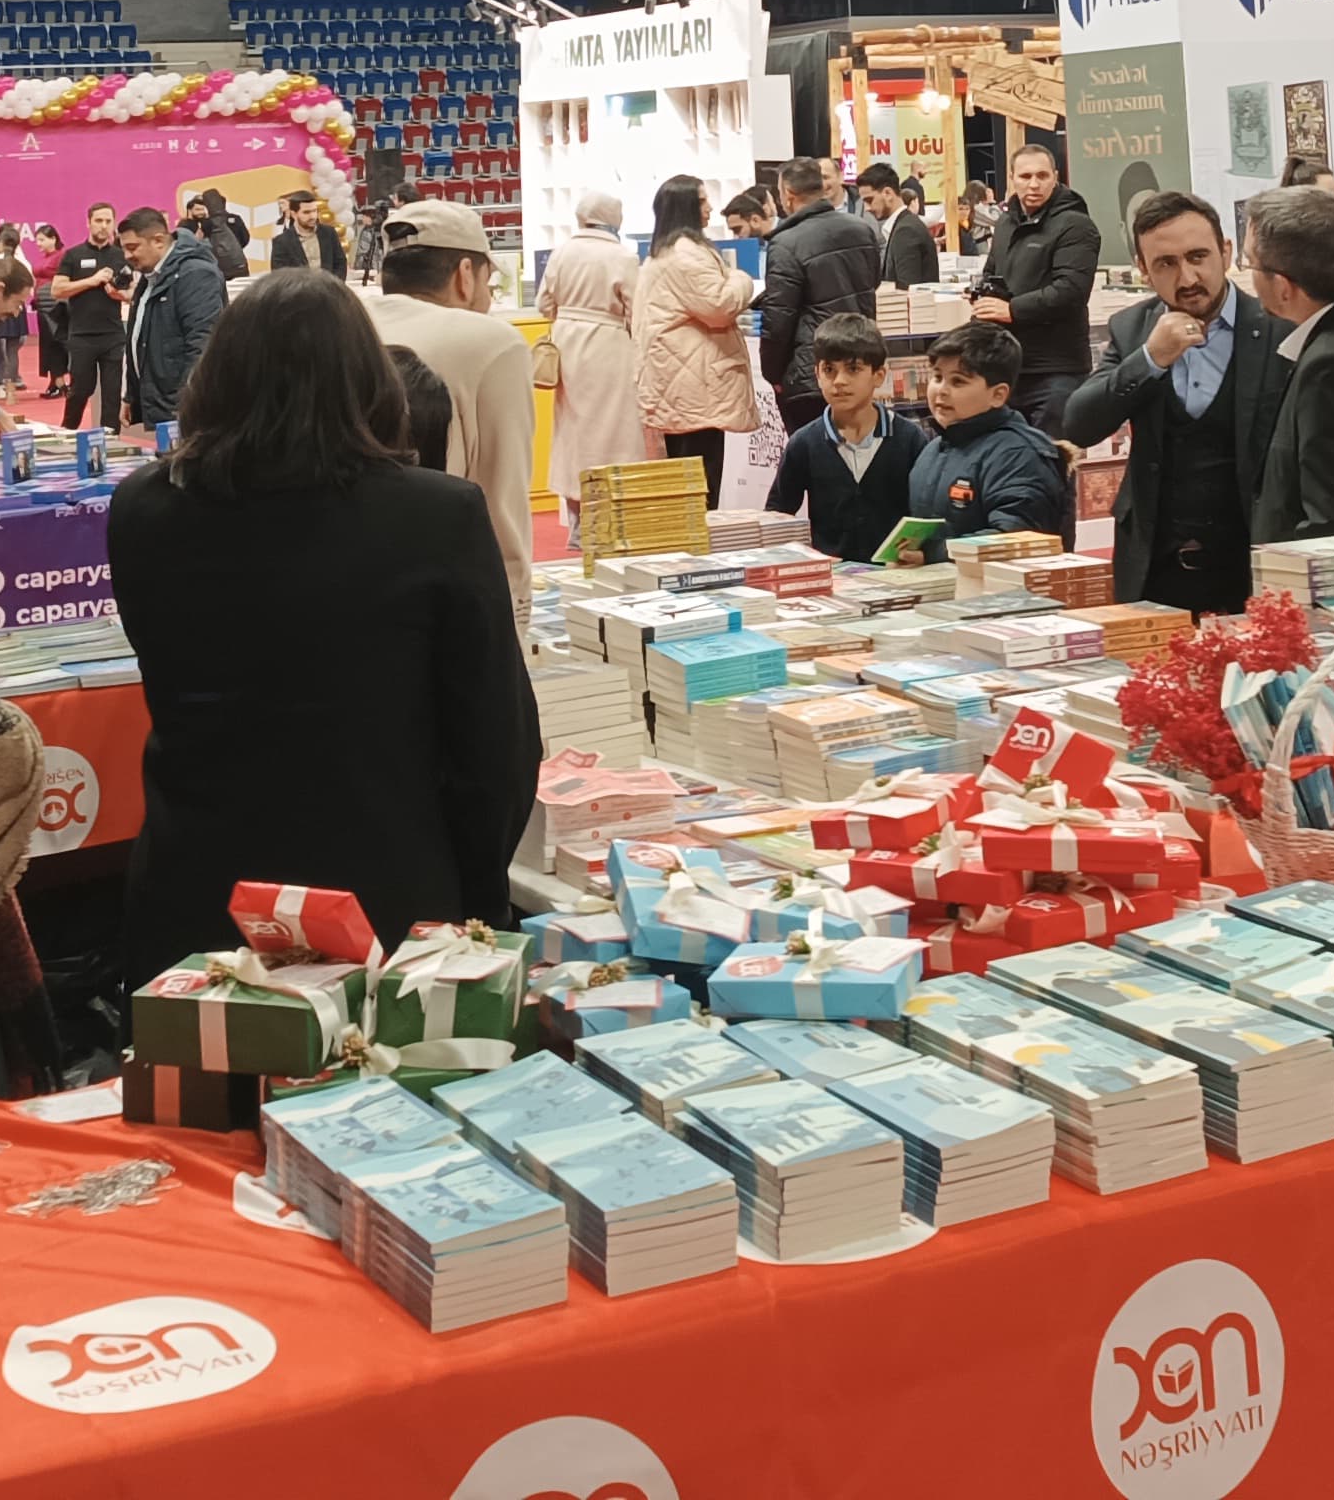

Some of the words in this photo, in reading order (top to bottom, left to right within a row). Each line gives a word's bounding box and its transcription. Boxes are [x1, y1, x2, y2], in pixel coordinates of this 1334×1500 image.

[613, 17, 713, 64] YAYIMLARI
[56, 1352, 257, 1402] NƏŞRİYYATI
[1121, 1404, 1264, 1476] NƏŞRİYYATI
